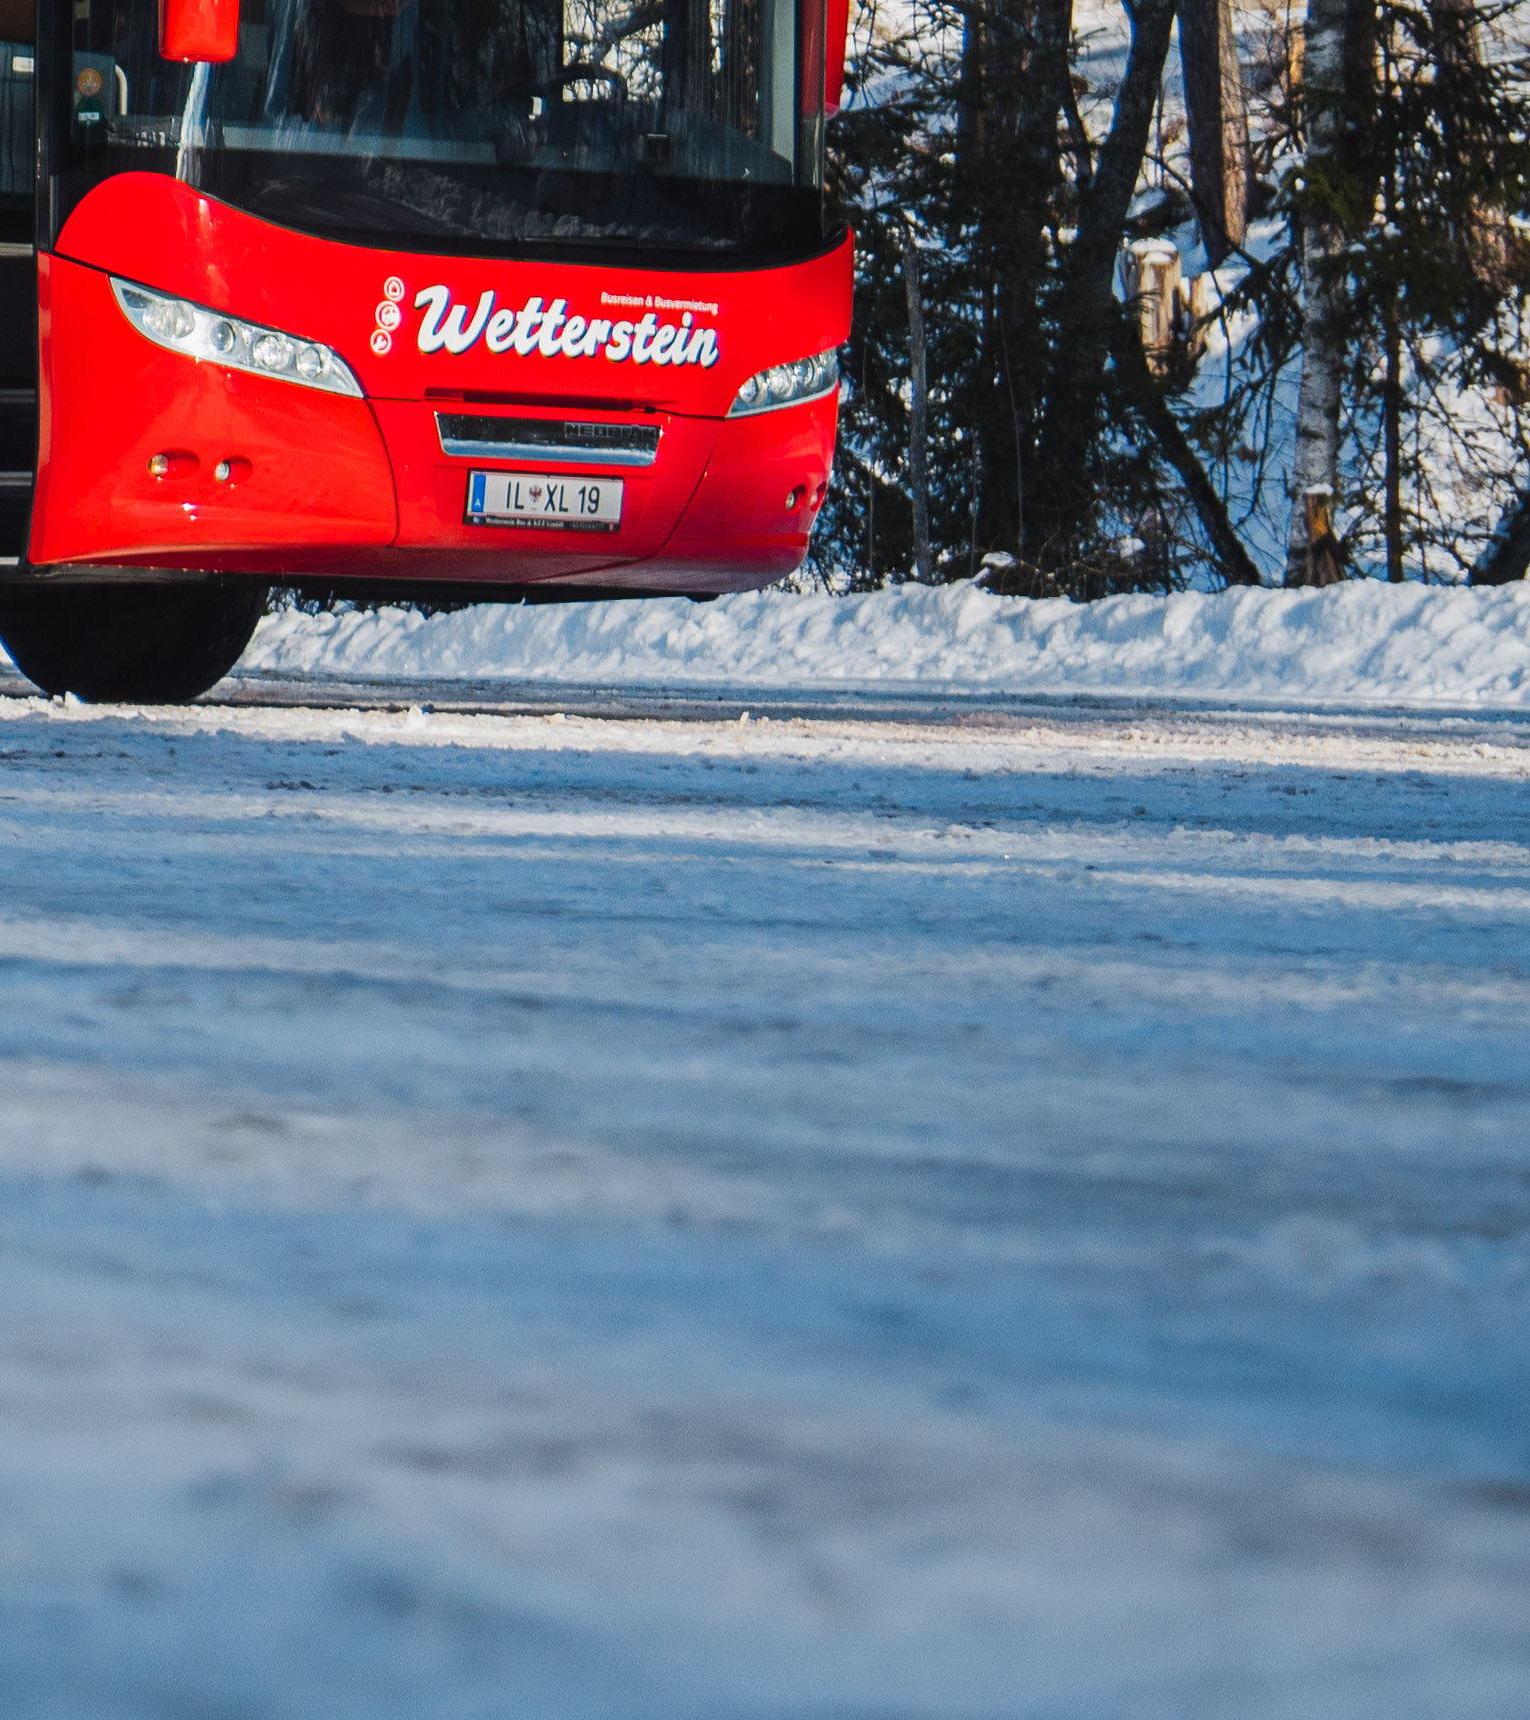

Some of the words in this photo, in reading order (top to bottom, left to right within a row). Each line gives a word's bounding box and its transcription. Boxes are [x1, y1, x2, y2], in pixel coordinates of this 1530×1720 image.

[600, 291, 645, 307] Busreisen
[645, 294, 653, 308] &
[654, 295, 719, 317] Busvermietung
[413, 284, 721, 370] Wetterstein
[506, 481, 525, 510] IL
[544, 483, 569, 513] XL
[578, 485, 601, 515] 19
